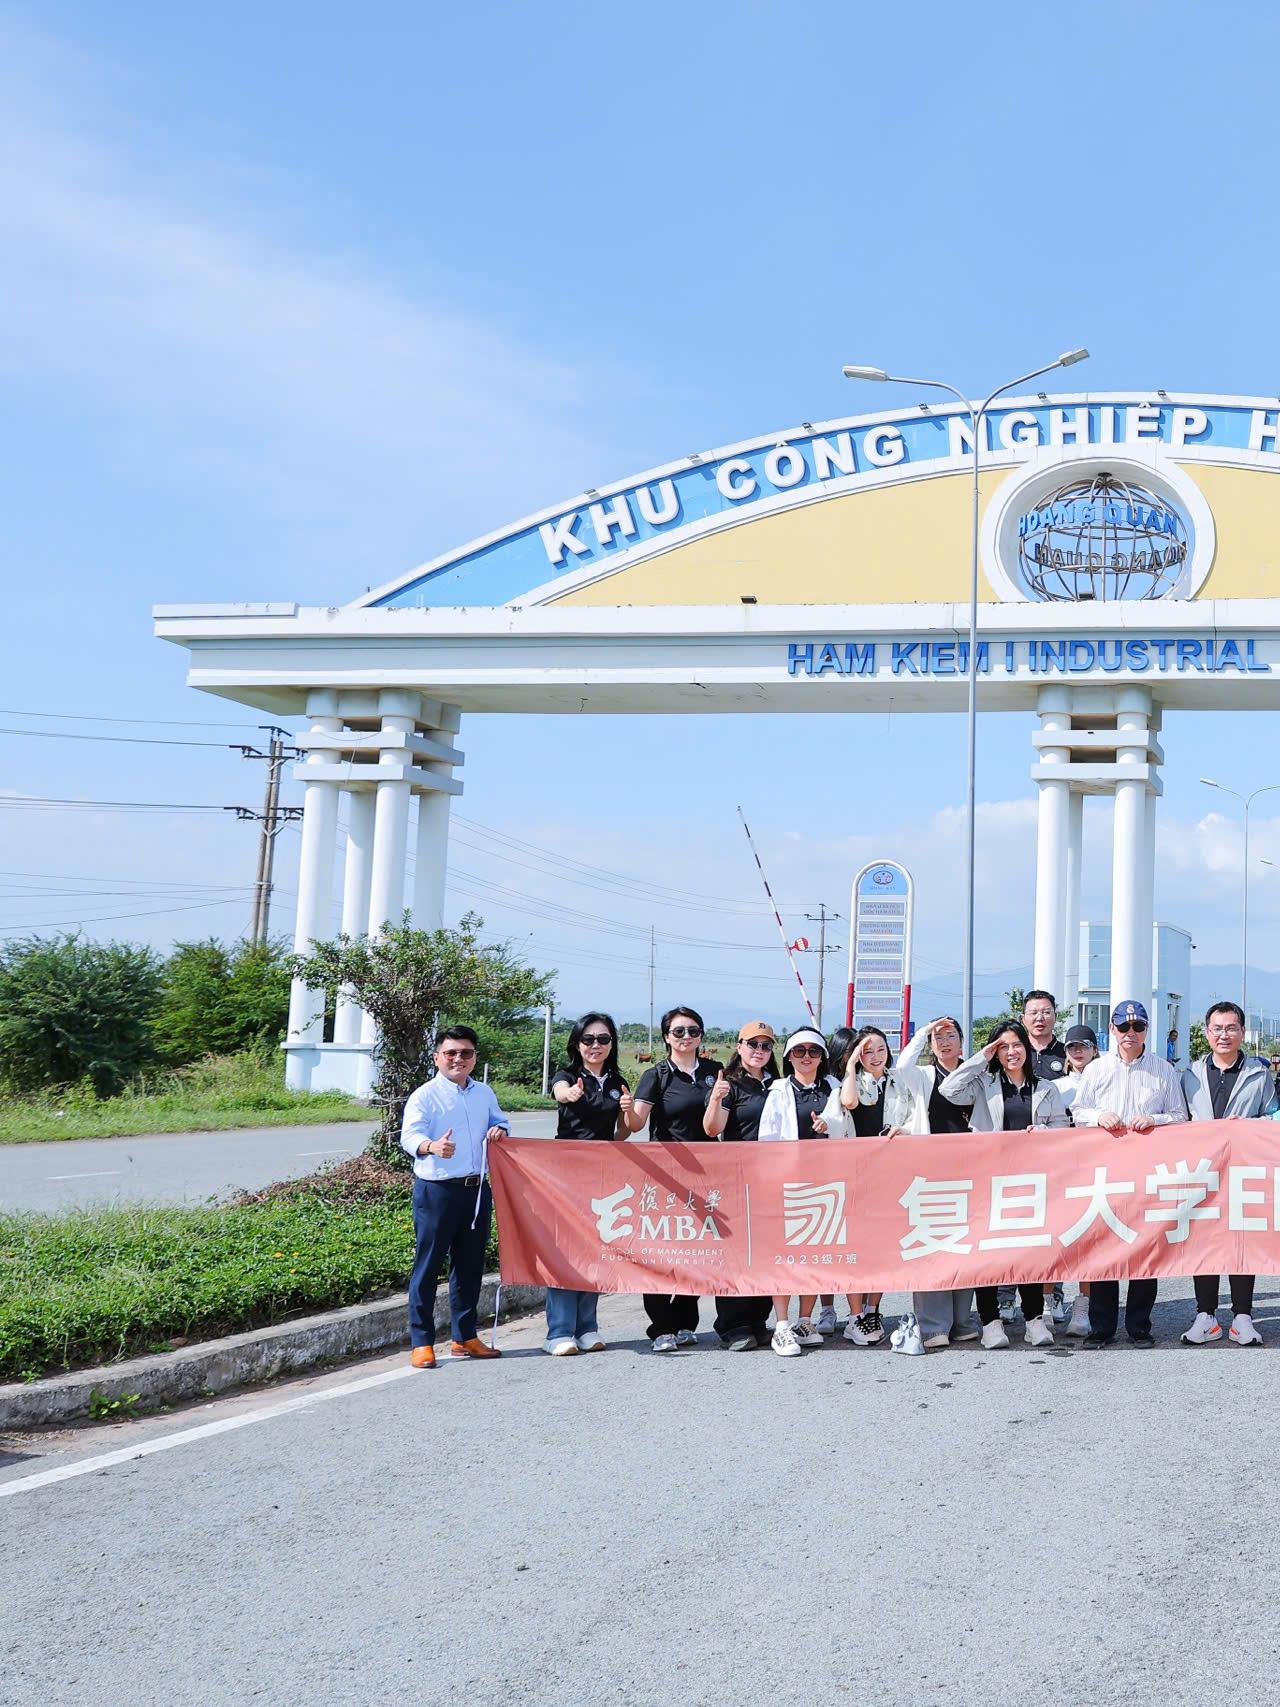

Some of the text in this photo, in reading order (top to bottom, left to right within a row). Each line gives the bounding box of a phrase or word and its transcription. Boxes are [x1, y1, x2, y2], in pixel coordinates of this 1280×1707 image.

[539, 478, 681, 565] KHU
[716, 424, 906, 501] CÔNG
[1104, 502, 1178, 534] QUAN
[787, 643, 876, 674] HAM
[891, 641, 989, 673] KIEM
[1006, 640, 1015, 672] I
[1029, 639, 1271, 672] INDUSTRIAL
[657, 1247, 723, 1257] MANAGEMENT
